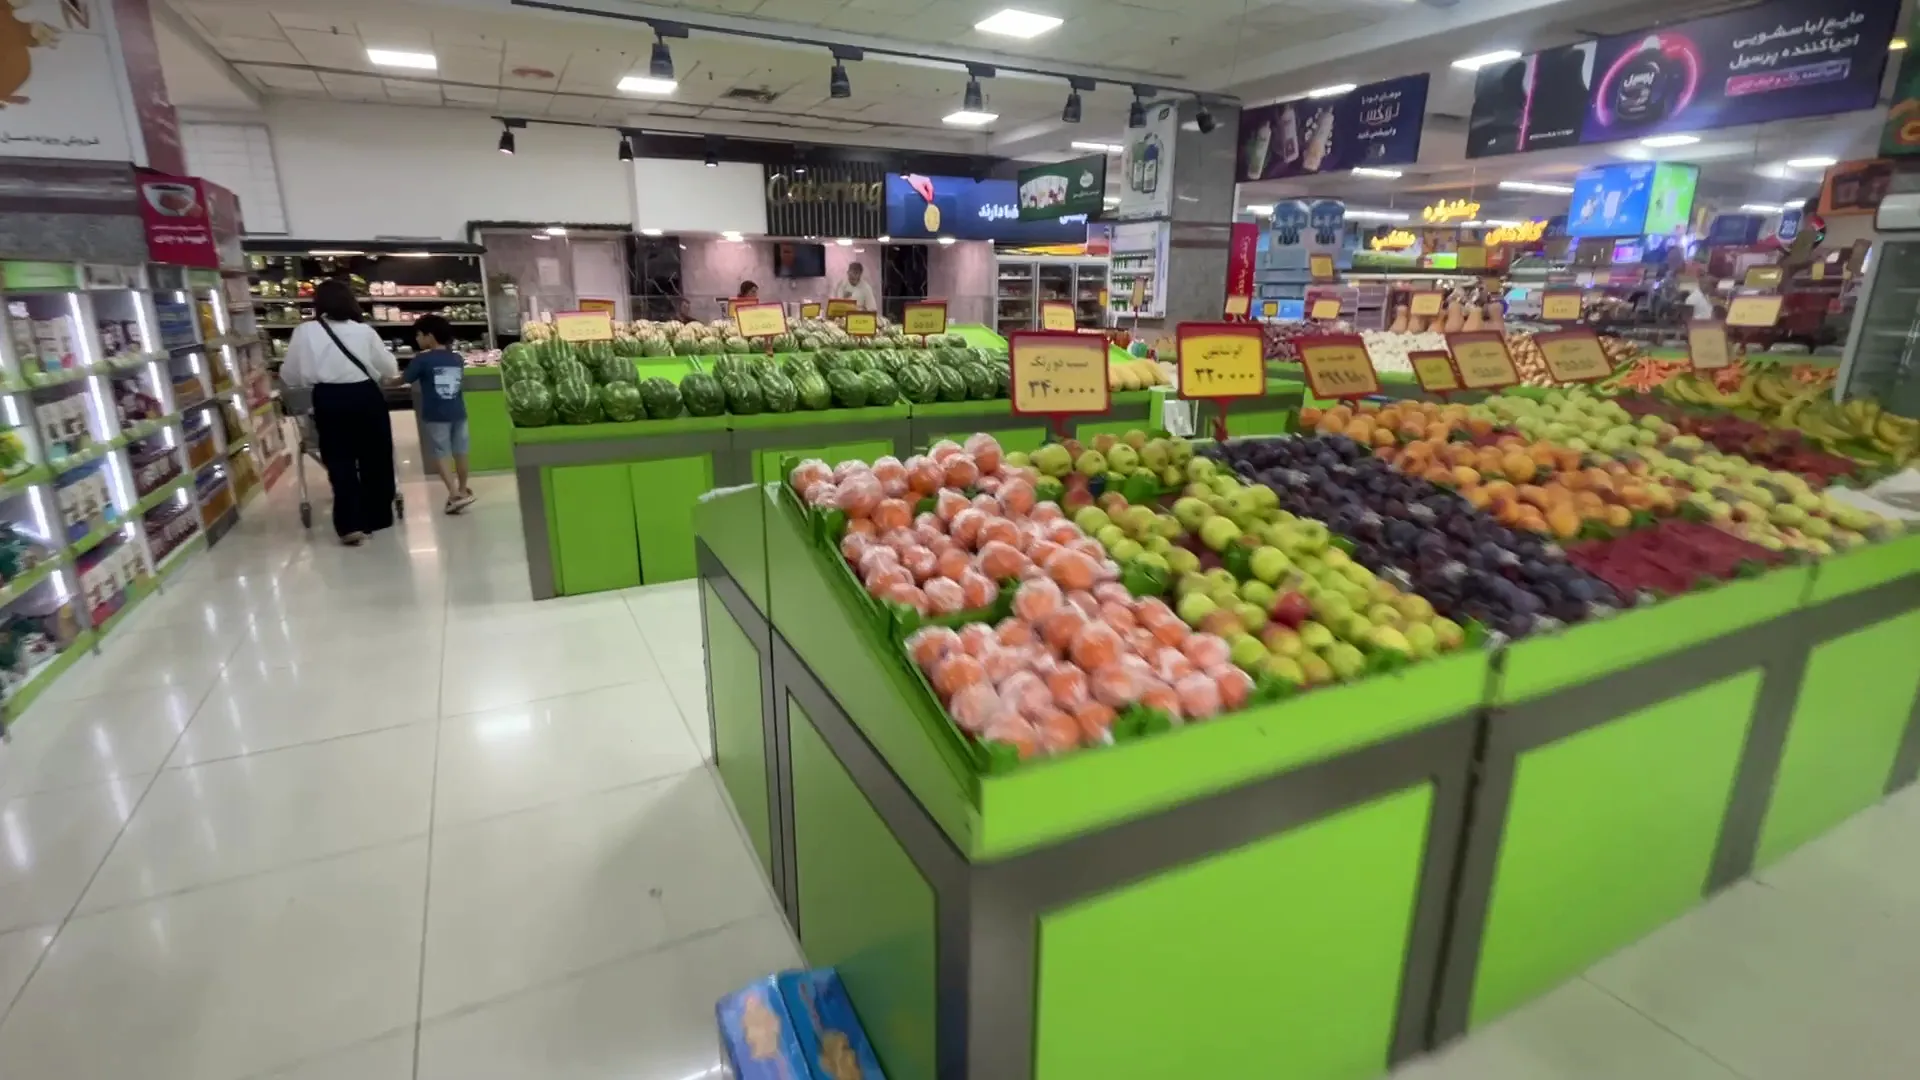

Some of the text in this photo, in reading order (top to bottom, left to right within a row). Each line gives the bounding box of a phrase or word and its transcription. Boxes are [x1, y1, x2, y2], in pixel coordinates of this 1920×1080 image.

[1823, 11, 1865, 35] مایع
[1729, 52, 1779, 70] پرسیل
[768, 173, 883, 210] Catering
